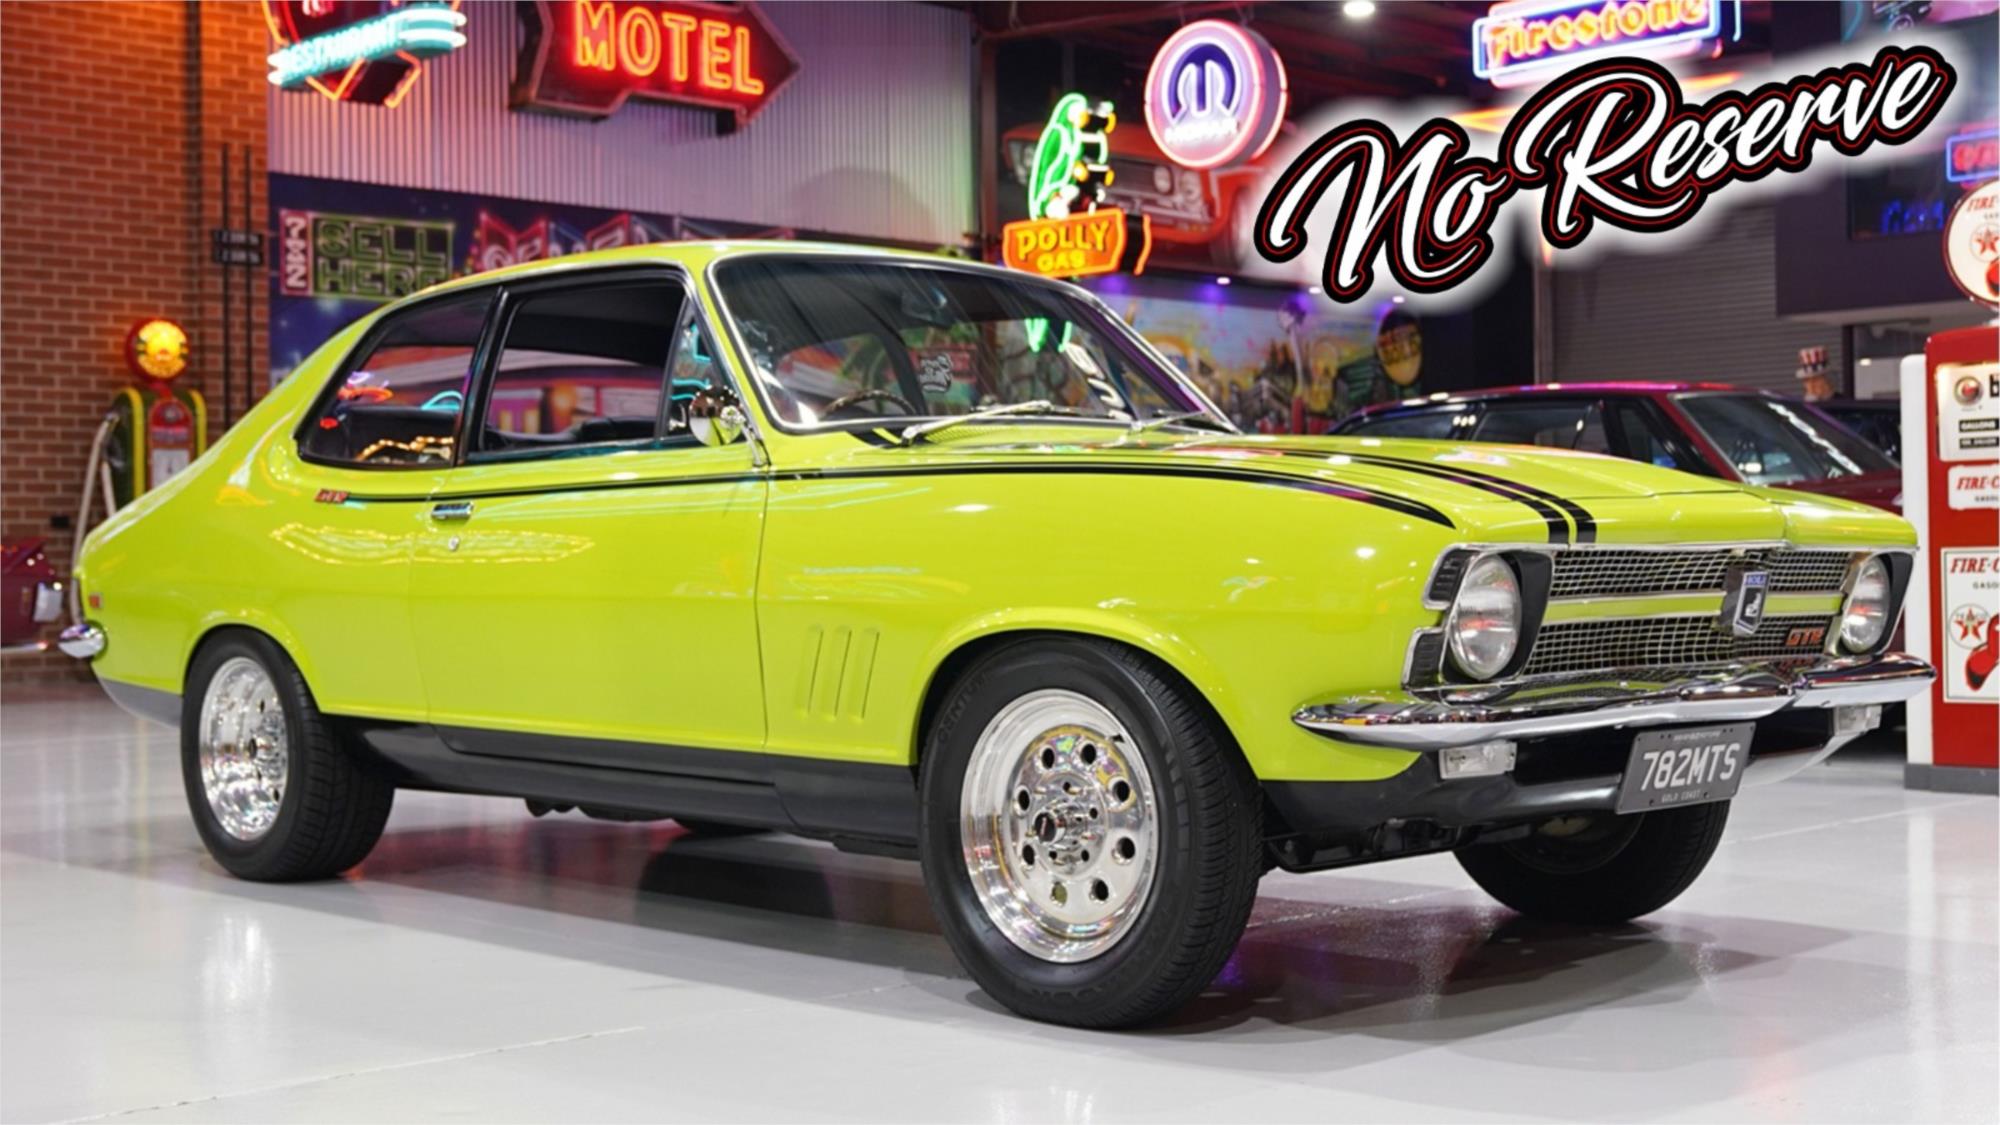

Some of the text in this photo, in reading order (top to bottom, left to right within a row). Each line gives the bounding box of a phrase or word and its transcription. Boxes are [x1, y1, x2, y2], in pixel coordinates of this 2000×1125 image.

[574, 0, 764, 96] MOTEL
[317, 220, 446, 266] SELL
[1016, 220, 1109, 261] POLLY
[1037, 249, 1086, 272] GAS
[317, 257, 446, 298] HERE
[1640, 743, 1740, 791] 782MTS
